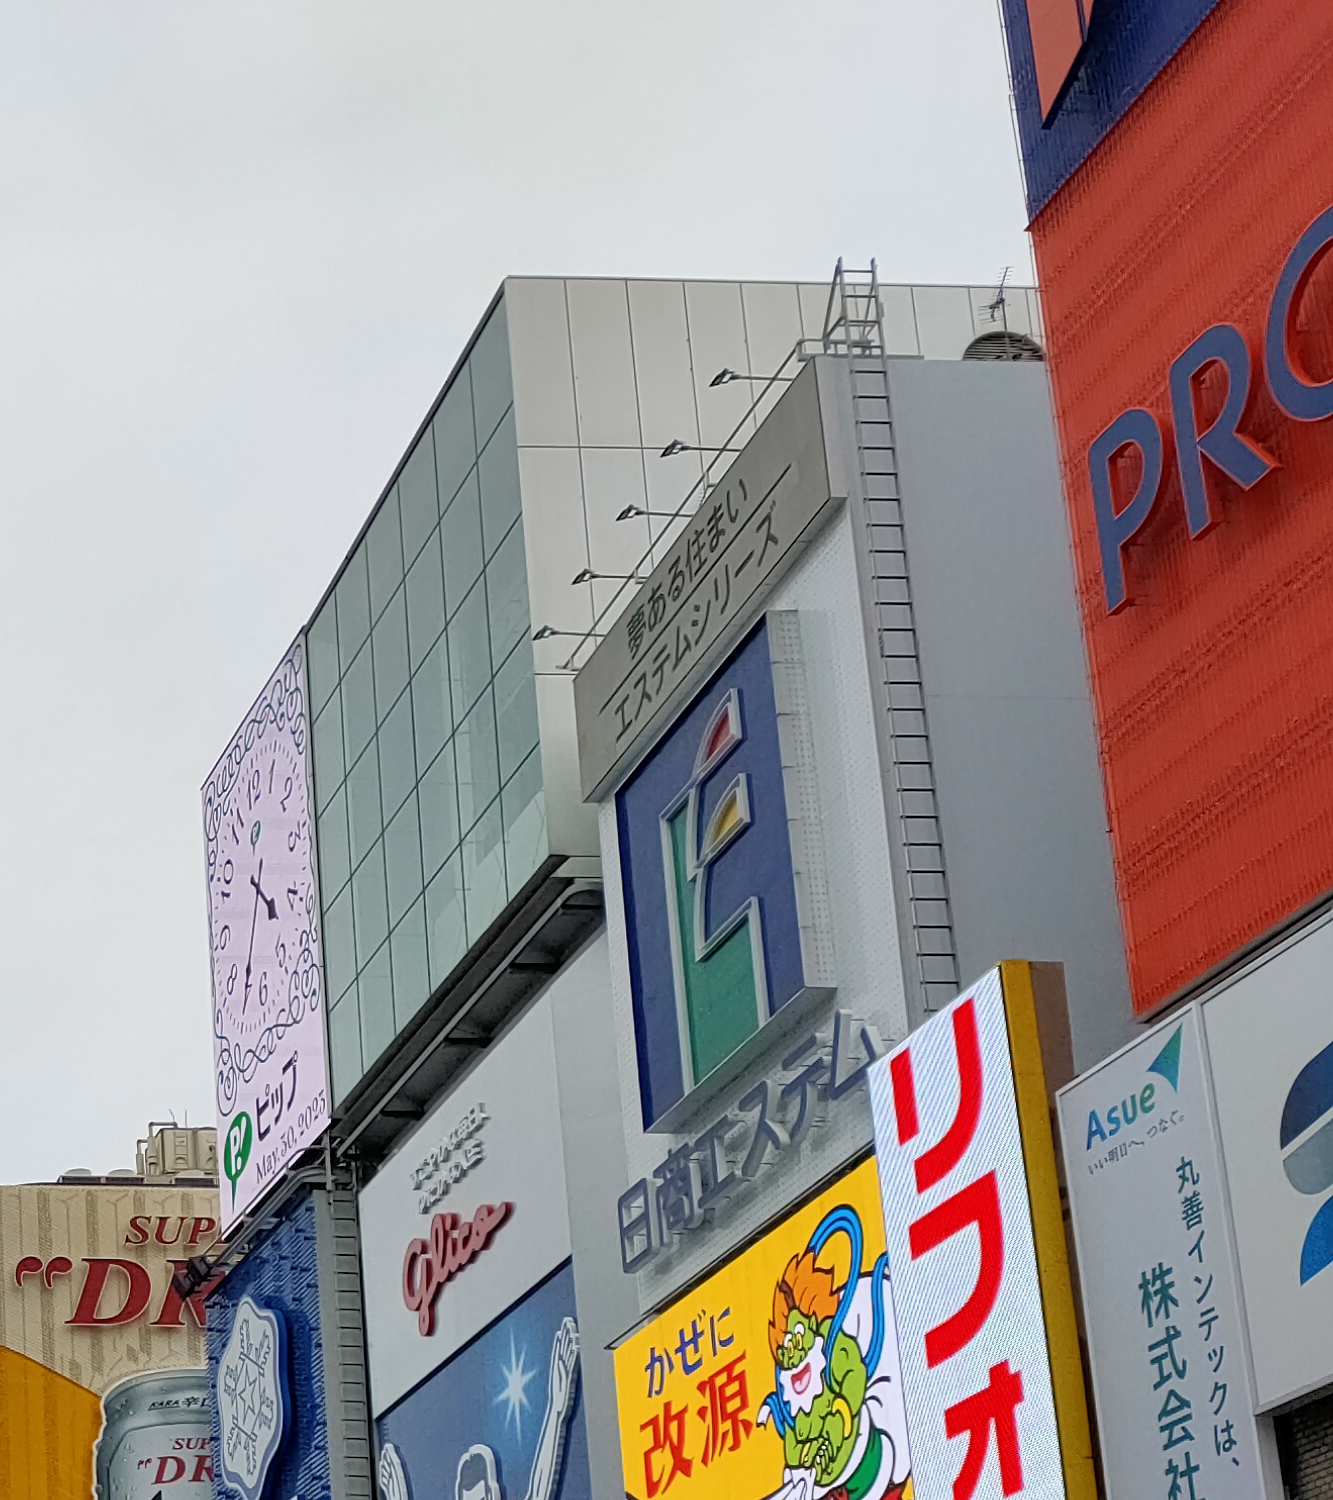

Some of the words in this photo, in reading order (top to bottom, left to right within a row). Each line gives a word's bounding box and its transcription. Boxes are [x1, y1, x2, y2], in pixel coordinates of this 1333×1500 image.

[613, 496, 781, 743] エステムシリーズ
[626, 481, 750, 660] 夢ある住まい
[255, 1050, 299, 1142] ピップ
[617, 1008, 885, 1276] 日商エステム
[1085, 1078, 1158, 1150] Asue
[124, 1215, 226, 1247] SUP
[402, 1201, 515, 1337] Glico
[644, 1304, 736, 1398] かぜに
[1176, 1155, 1240, 1468] 丸善インテックは、
[639, 1349, 754, 1497] 改源
